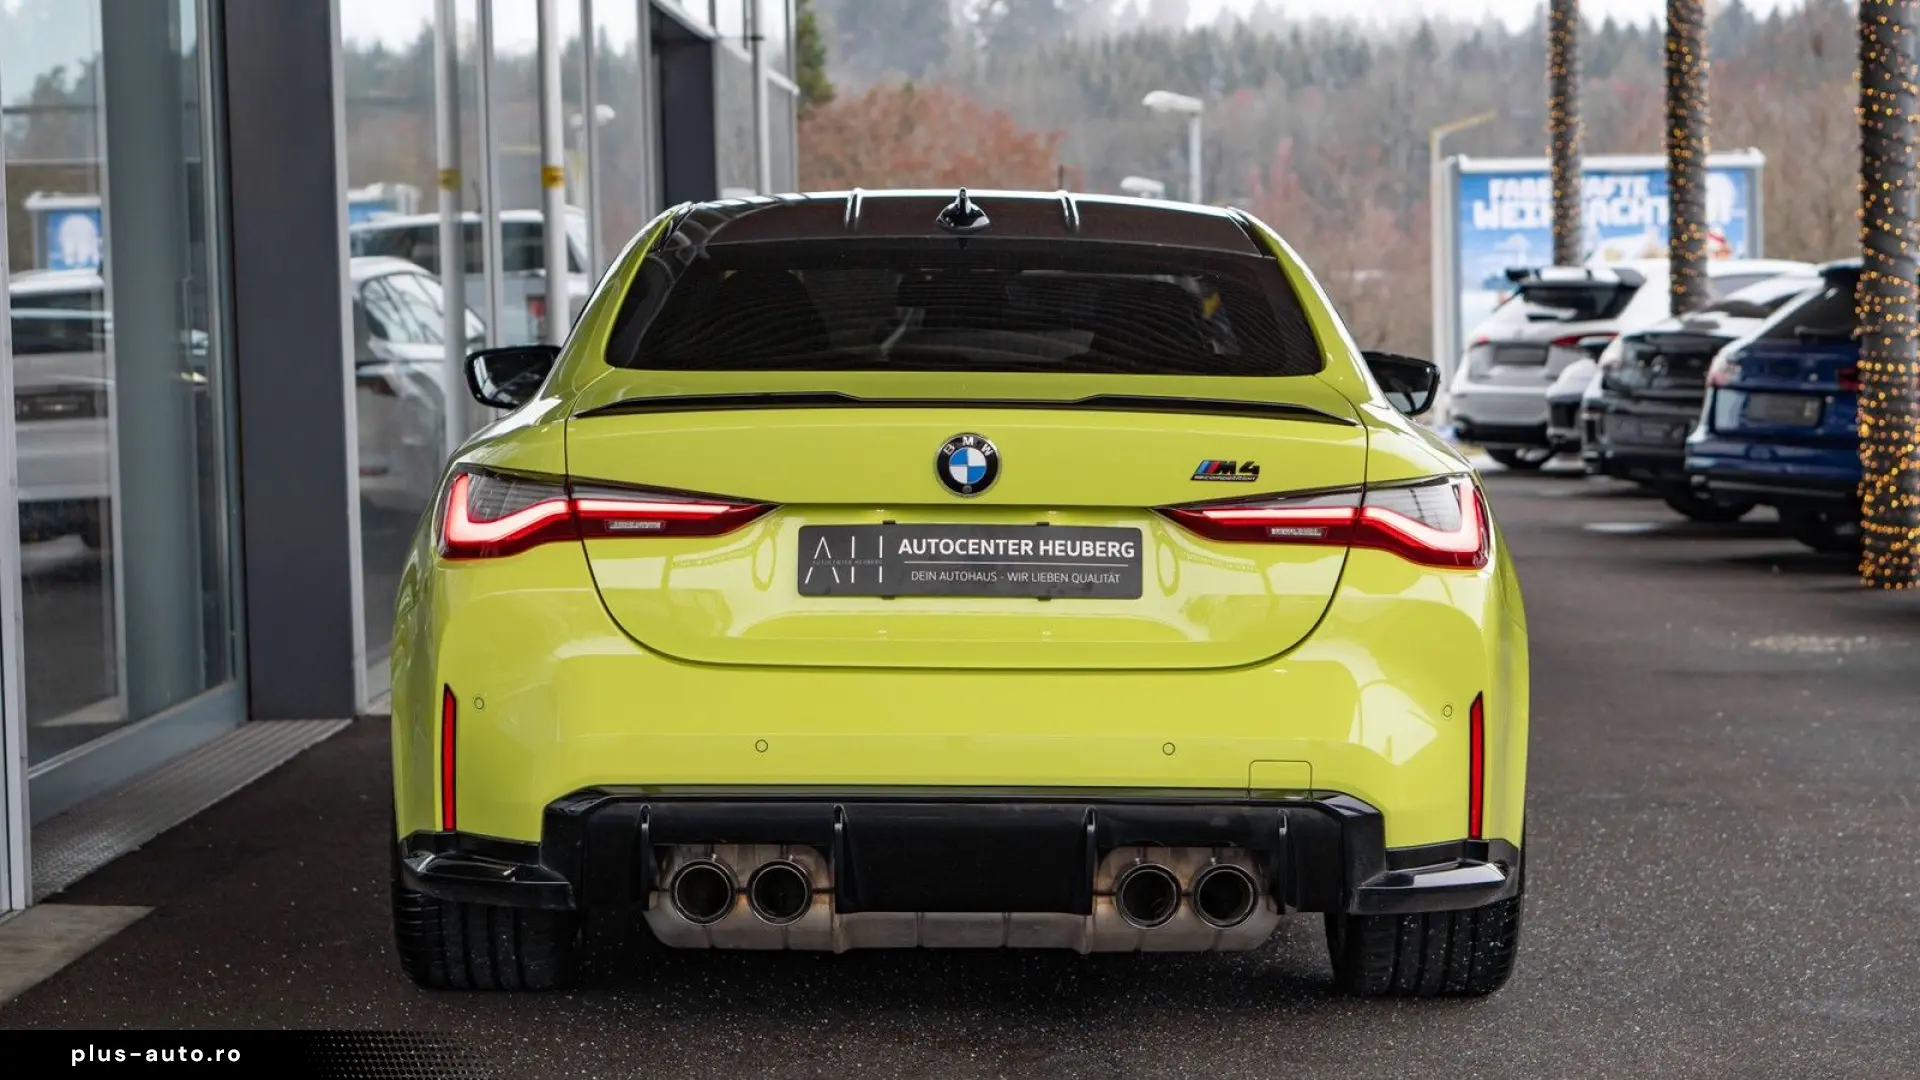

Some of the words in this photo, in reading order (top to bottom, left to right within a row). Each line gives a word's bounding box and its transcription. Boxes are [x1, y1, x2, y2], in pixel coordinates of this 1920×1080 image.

[943, 436, 994, 456] BMW
[1208, 460, 1260, 475] M4
[898, 538, 1033, 556] AUTOCENTER
[1039, 539, 1135, 558] HEUBERG
[805, 535, 883, 584] AH
[911, 570, 937, 581] DEIN
[939, 571, 997, 582] AUTOHAUS
[1007, 572, 1029, 583] WIR
[1031, 572, 1069, 583] LIEBEN
[1071, 571, 1121, 584] QUALITÄT
